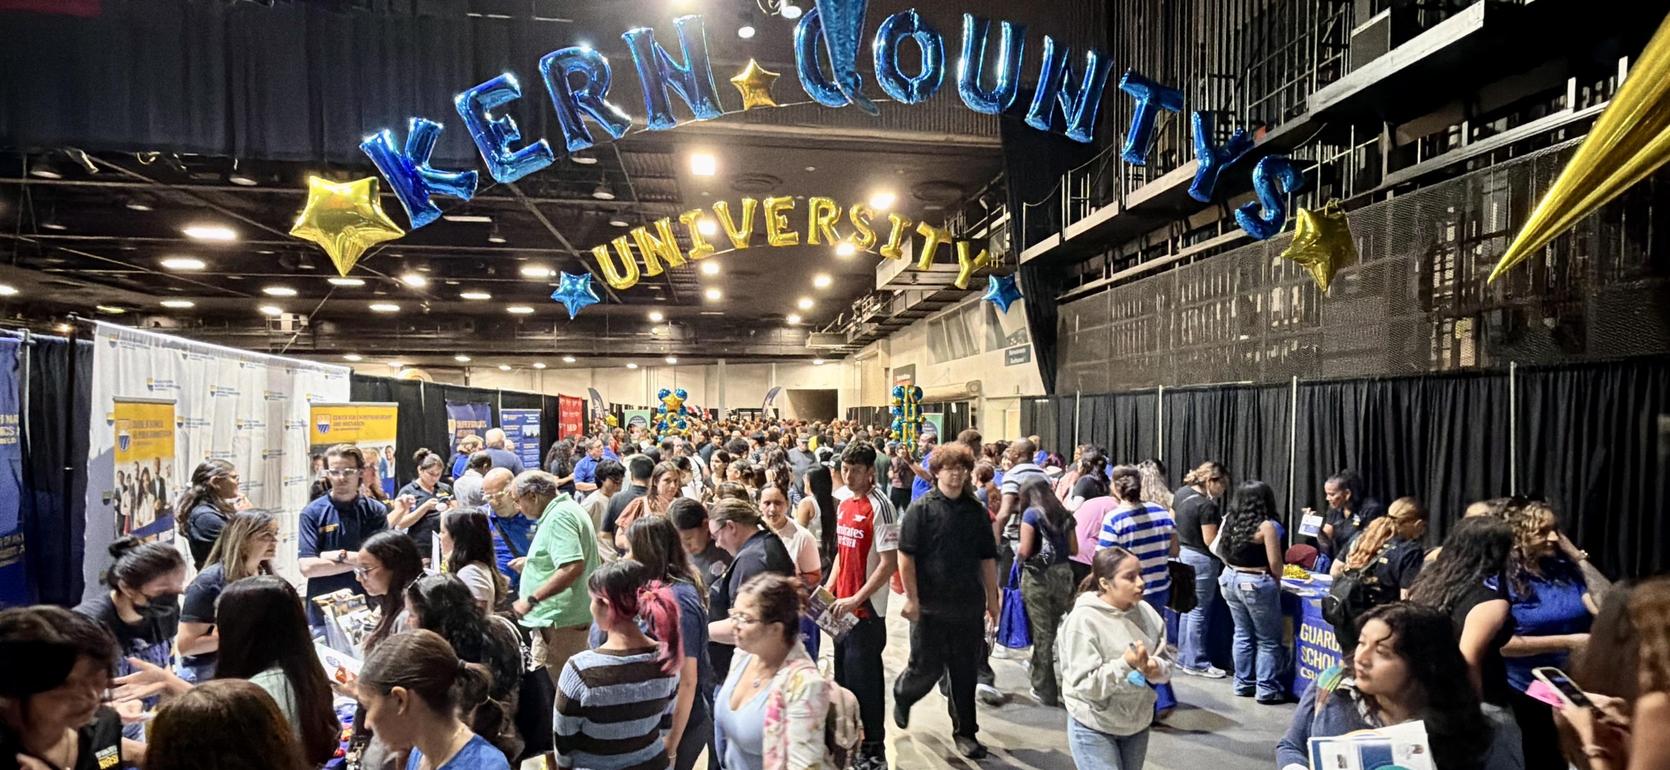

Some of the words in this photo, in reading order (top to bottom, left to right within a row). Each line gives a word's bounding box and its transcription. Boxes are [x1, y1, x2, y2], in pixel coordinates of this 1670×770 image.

[359, 14, 724, 230] KERN
[592, 194, 990, 290] UNIVERSITY
[836, 524, 865, 540] mirates
[1300, 623, 1343, 653] GUARD
[1300, 666, 1318, 681] CSU
